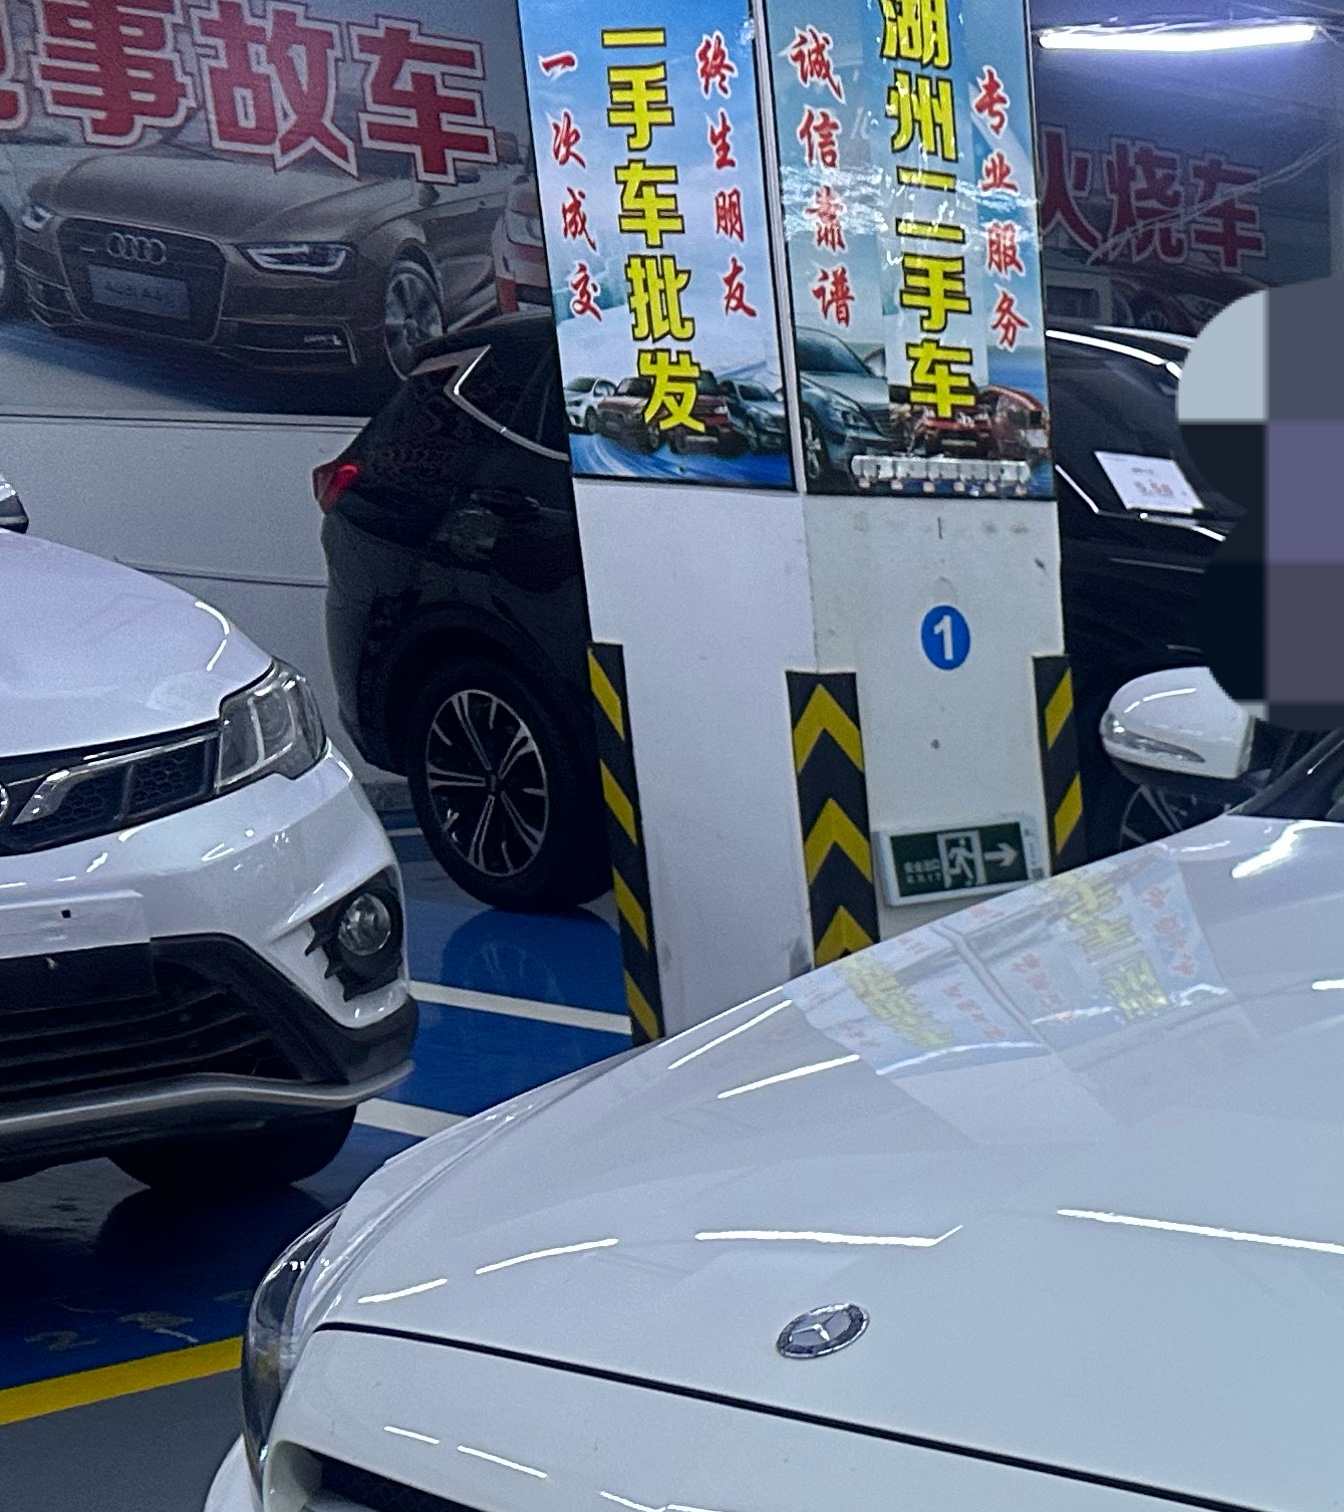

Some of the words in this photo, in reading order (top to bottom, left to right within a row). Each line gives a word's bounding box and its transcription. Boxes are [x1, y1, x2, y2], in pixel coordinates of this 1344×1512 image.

[539, 51, 602, 322] 一次成交
[697, 33, 757, 318] 终生朋友
[789, 26, 855, 327] 诚信靠谱
[880, 0, 978, 420] 湖州二手车
[974, 67, 1030, 349] 专业服务
[934, 616, 954, 661] 1
